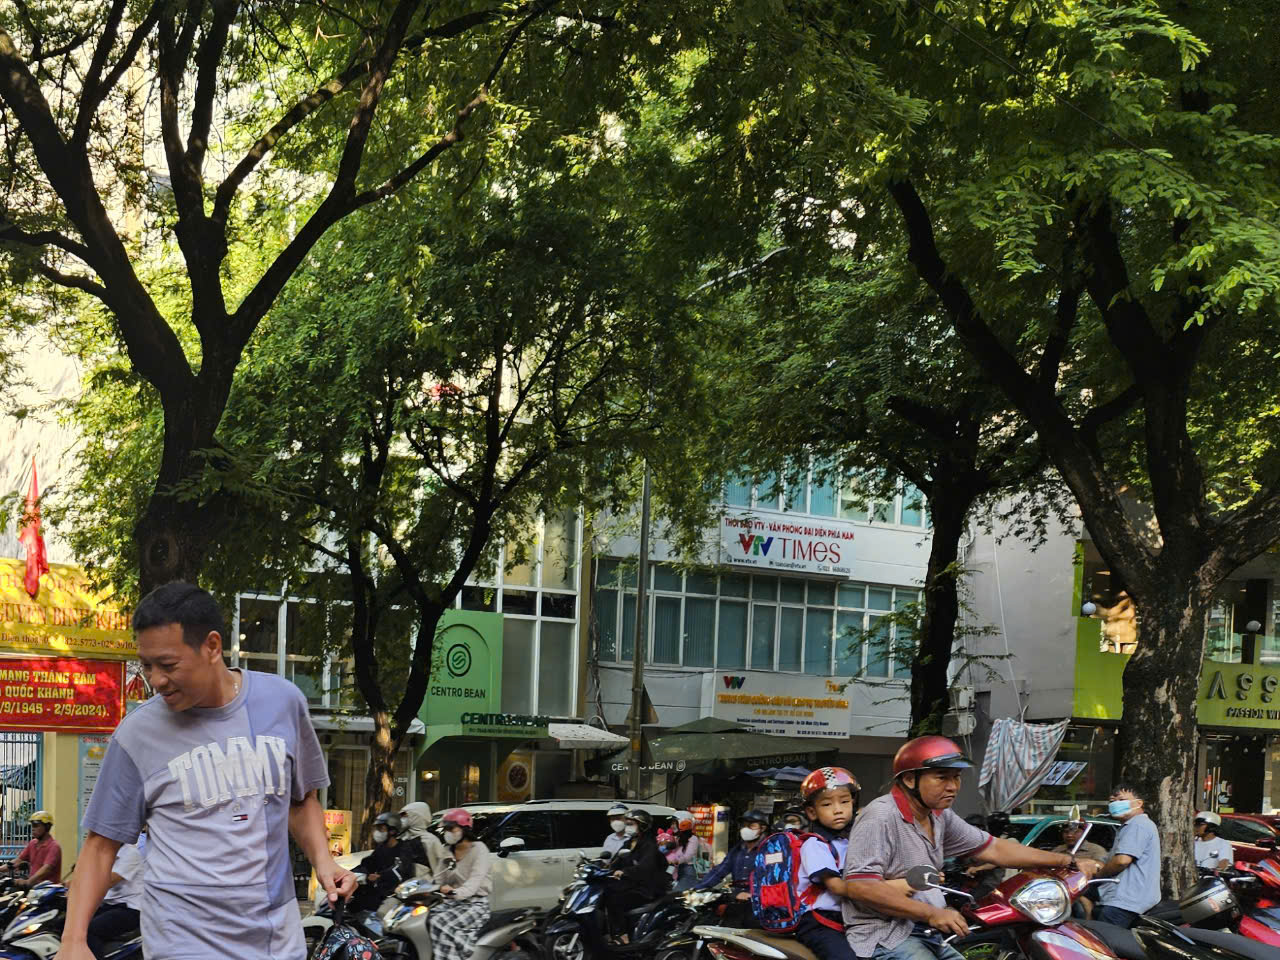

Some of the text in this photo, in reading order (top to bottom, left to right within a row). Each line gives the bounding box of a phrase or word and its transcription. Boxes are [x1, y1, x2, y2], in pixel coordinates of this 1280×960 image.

[754, 521, 765, 531] VTV
[842, 531, 855, 541] NAM
[739, 533, 774, 557] VTV
[33, 669, 69, 684] THÁNG
[73, 670, 96, 685] TÁM
[723, 675, 746, 690] VTV
[5, 683, 33, 700] QUỐC
[37, 683, 74, 699] KHÁNH
[431, 686, 486, 699] CENTRO BEAN
[54, 703, 110, 718] 2/9/2024).
[1226, 707, 1264, 719] PASSION
[460, 712, 512, 726] CENTRO
[168, 735, 287, 811] TOMMY
